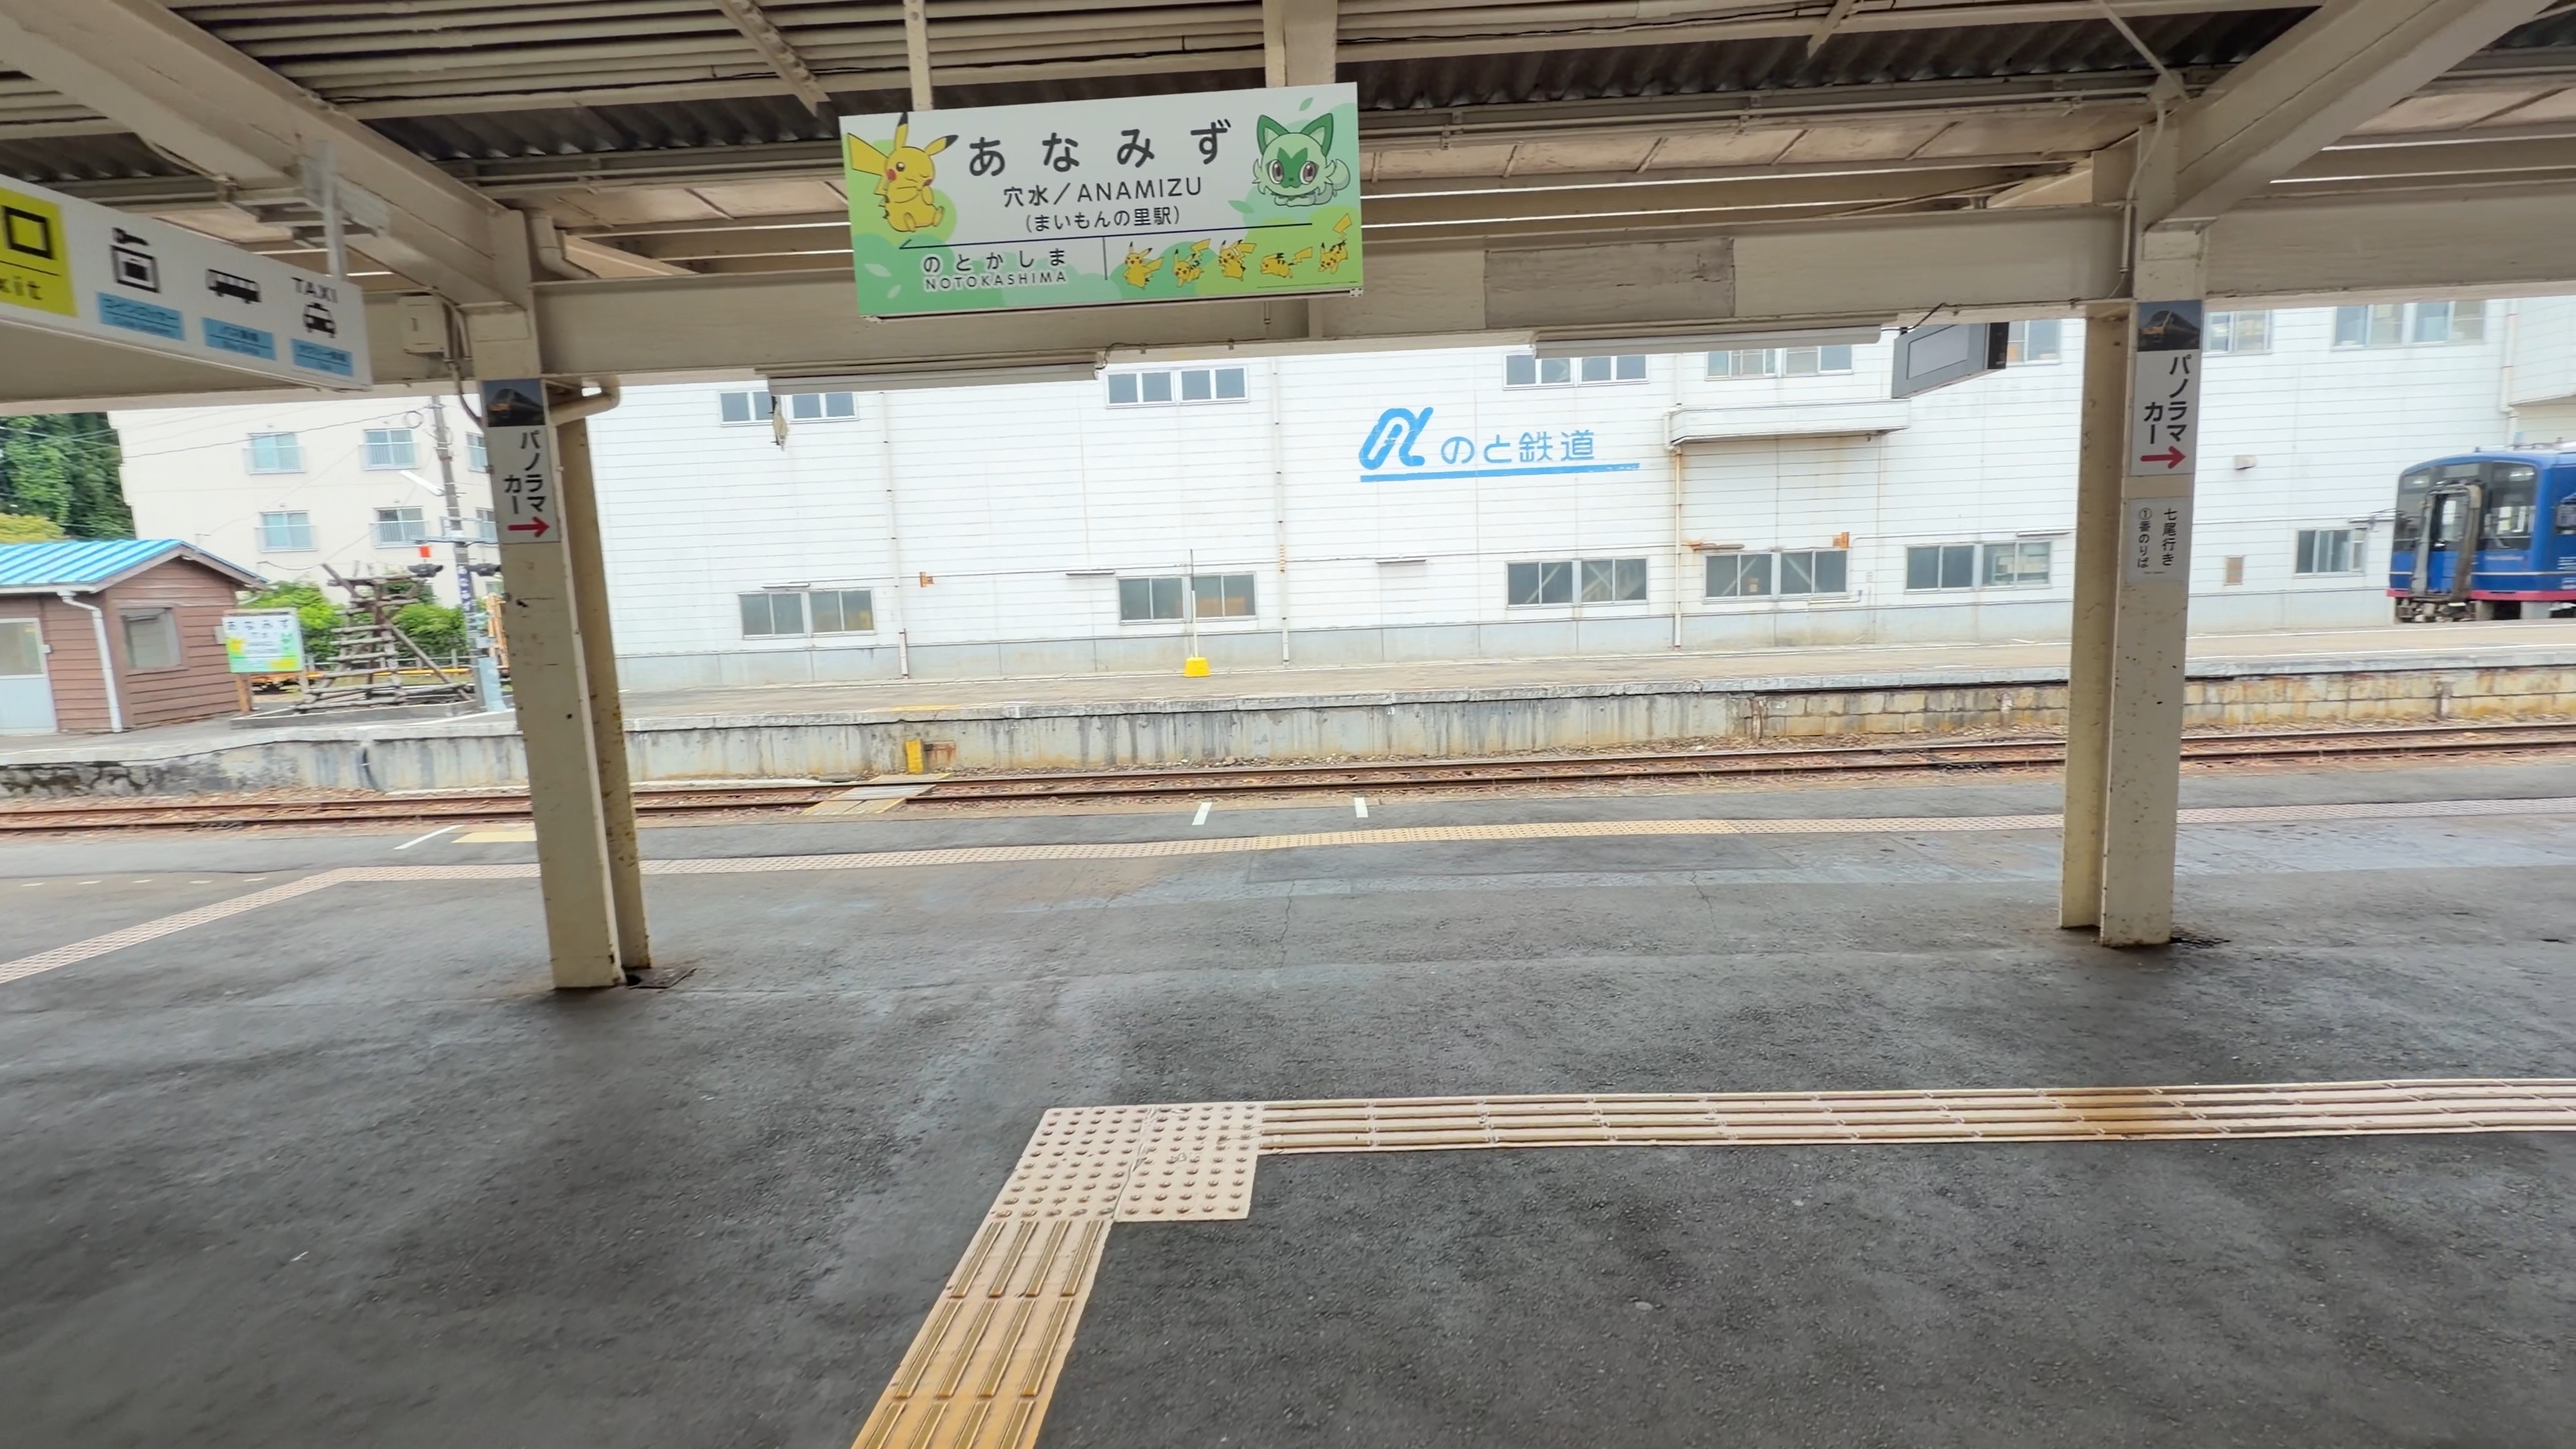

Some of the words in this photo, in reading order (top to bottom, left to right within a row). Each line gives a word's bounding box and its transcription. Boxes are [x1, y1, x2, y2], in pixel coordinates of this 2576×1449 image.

[969, 119, 1231, 176] あなみず
[1026, 206, 1179, 233] (まいもんの里駅)
[925, 248, 1065, 273] のとかしま
[0, 275, 43, 301] xit
[291, 276, 338, 303] TAXI
[926, 272, 1066, 290] NOTOKASHIMA
[2167, 354, 2192, 442] パノラマ
[2143, 402, 2163, 444] カー
[1441, 430, 1594, 465] のと鉄道
[503, 474, 522, 515] カー
